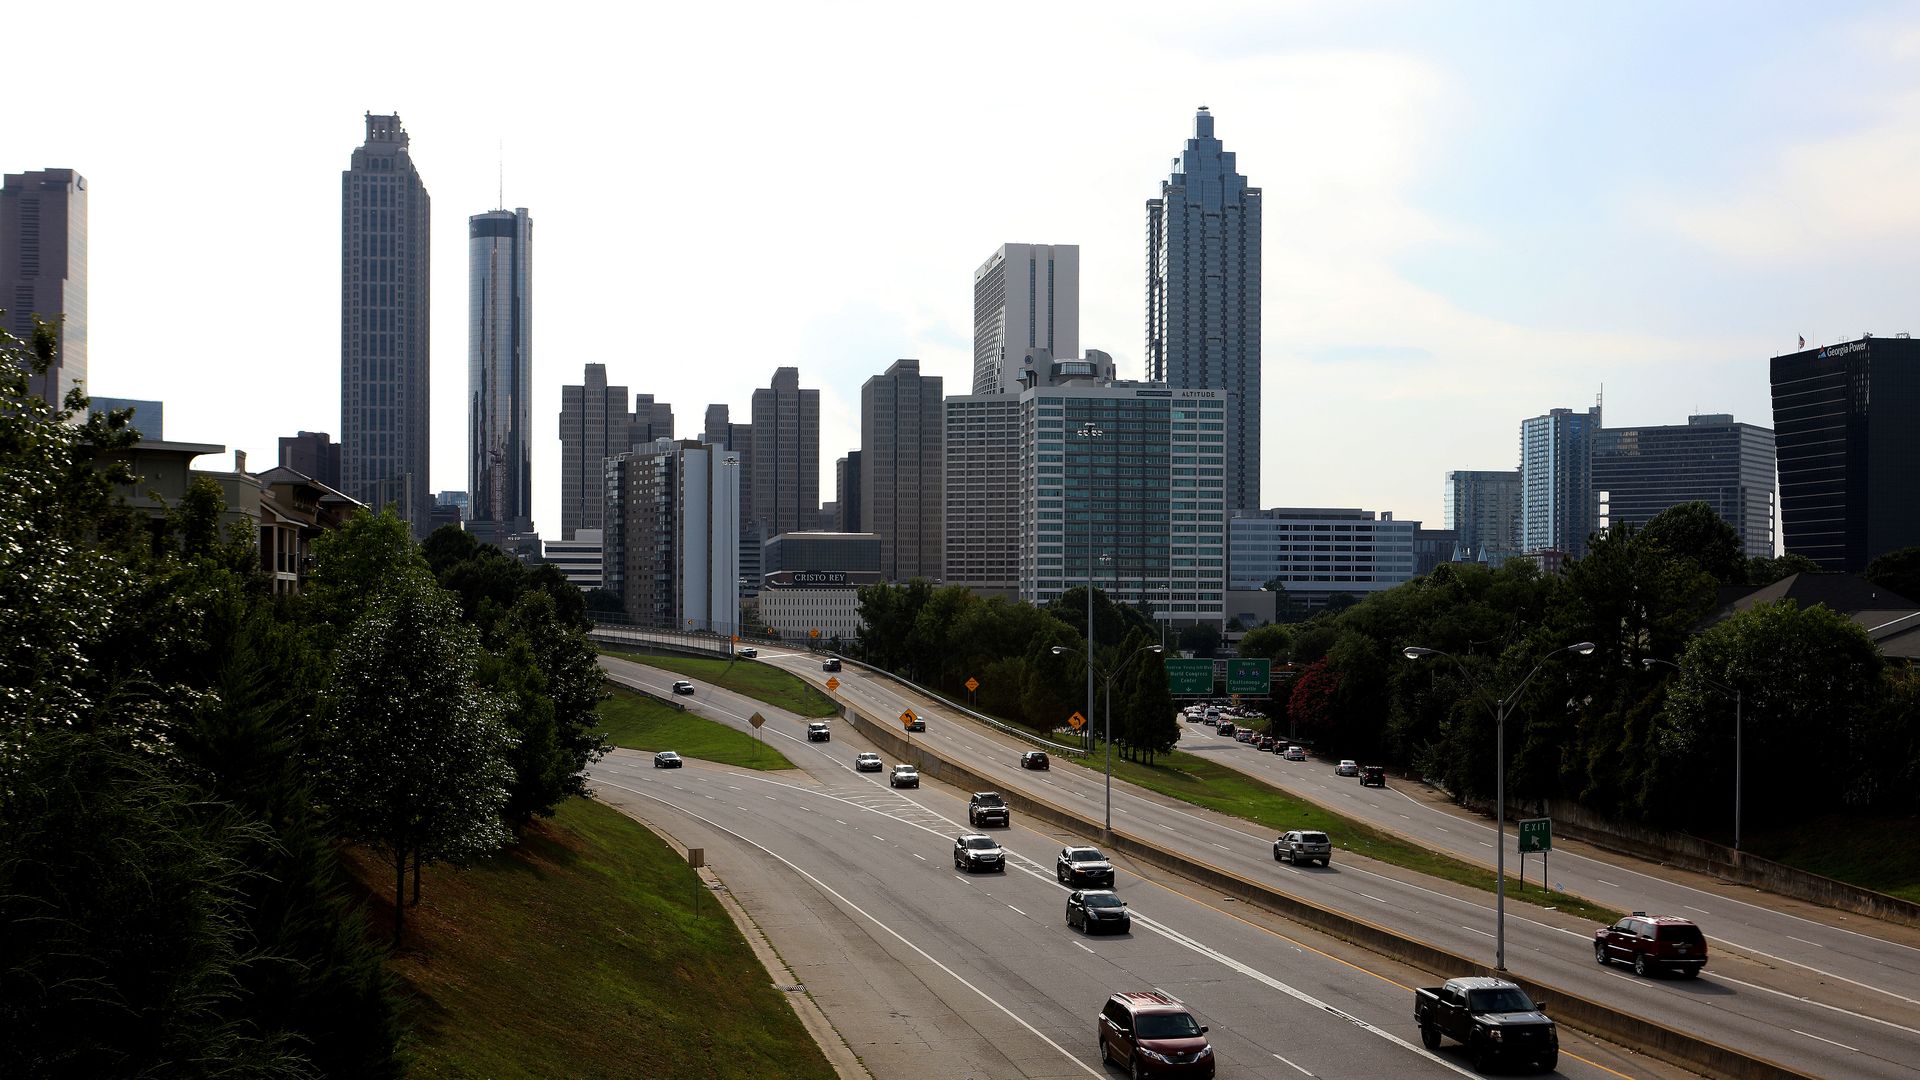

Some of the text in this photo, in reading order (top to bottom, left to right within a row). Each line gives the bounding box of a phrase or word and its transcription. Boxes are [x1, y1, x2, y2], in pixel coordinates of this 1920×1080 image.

[1827, 342, 1866, 357] Georgia Power
[1524, 822, 1546, 831] EXIT
